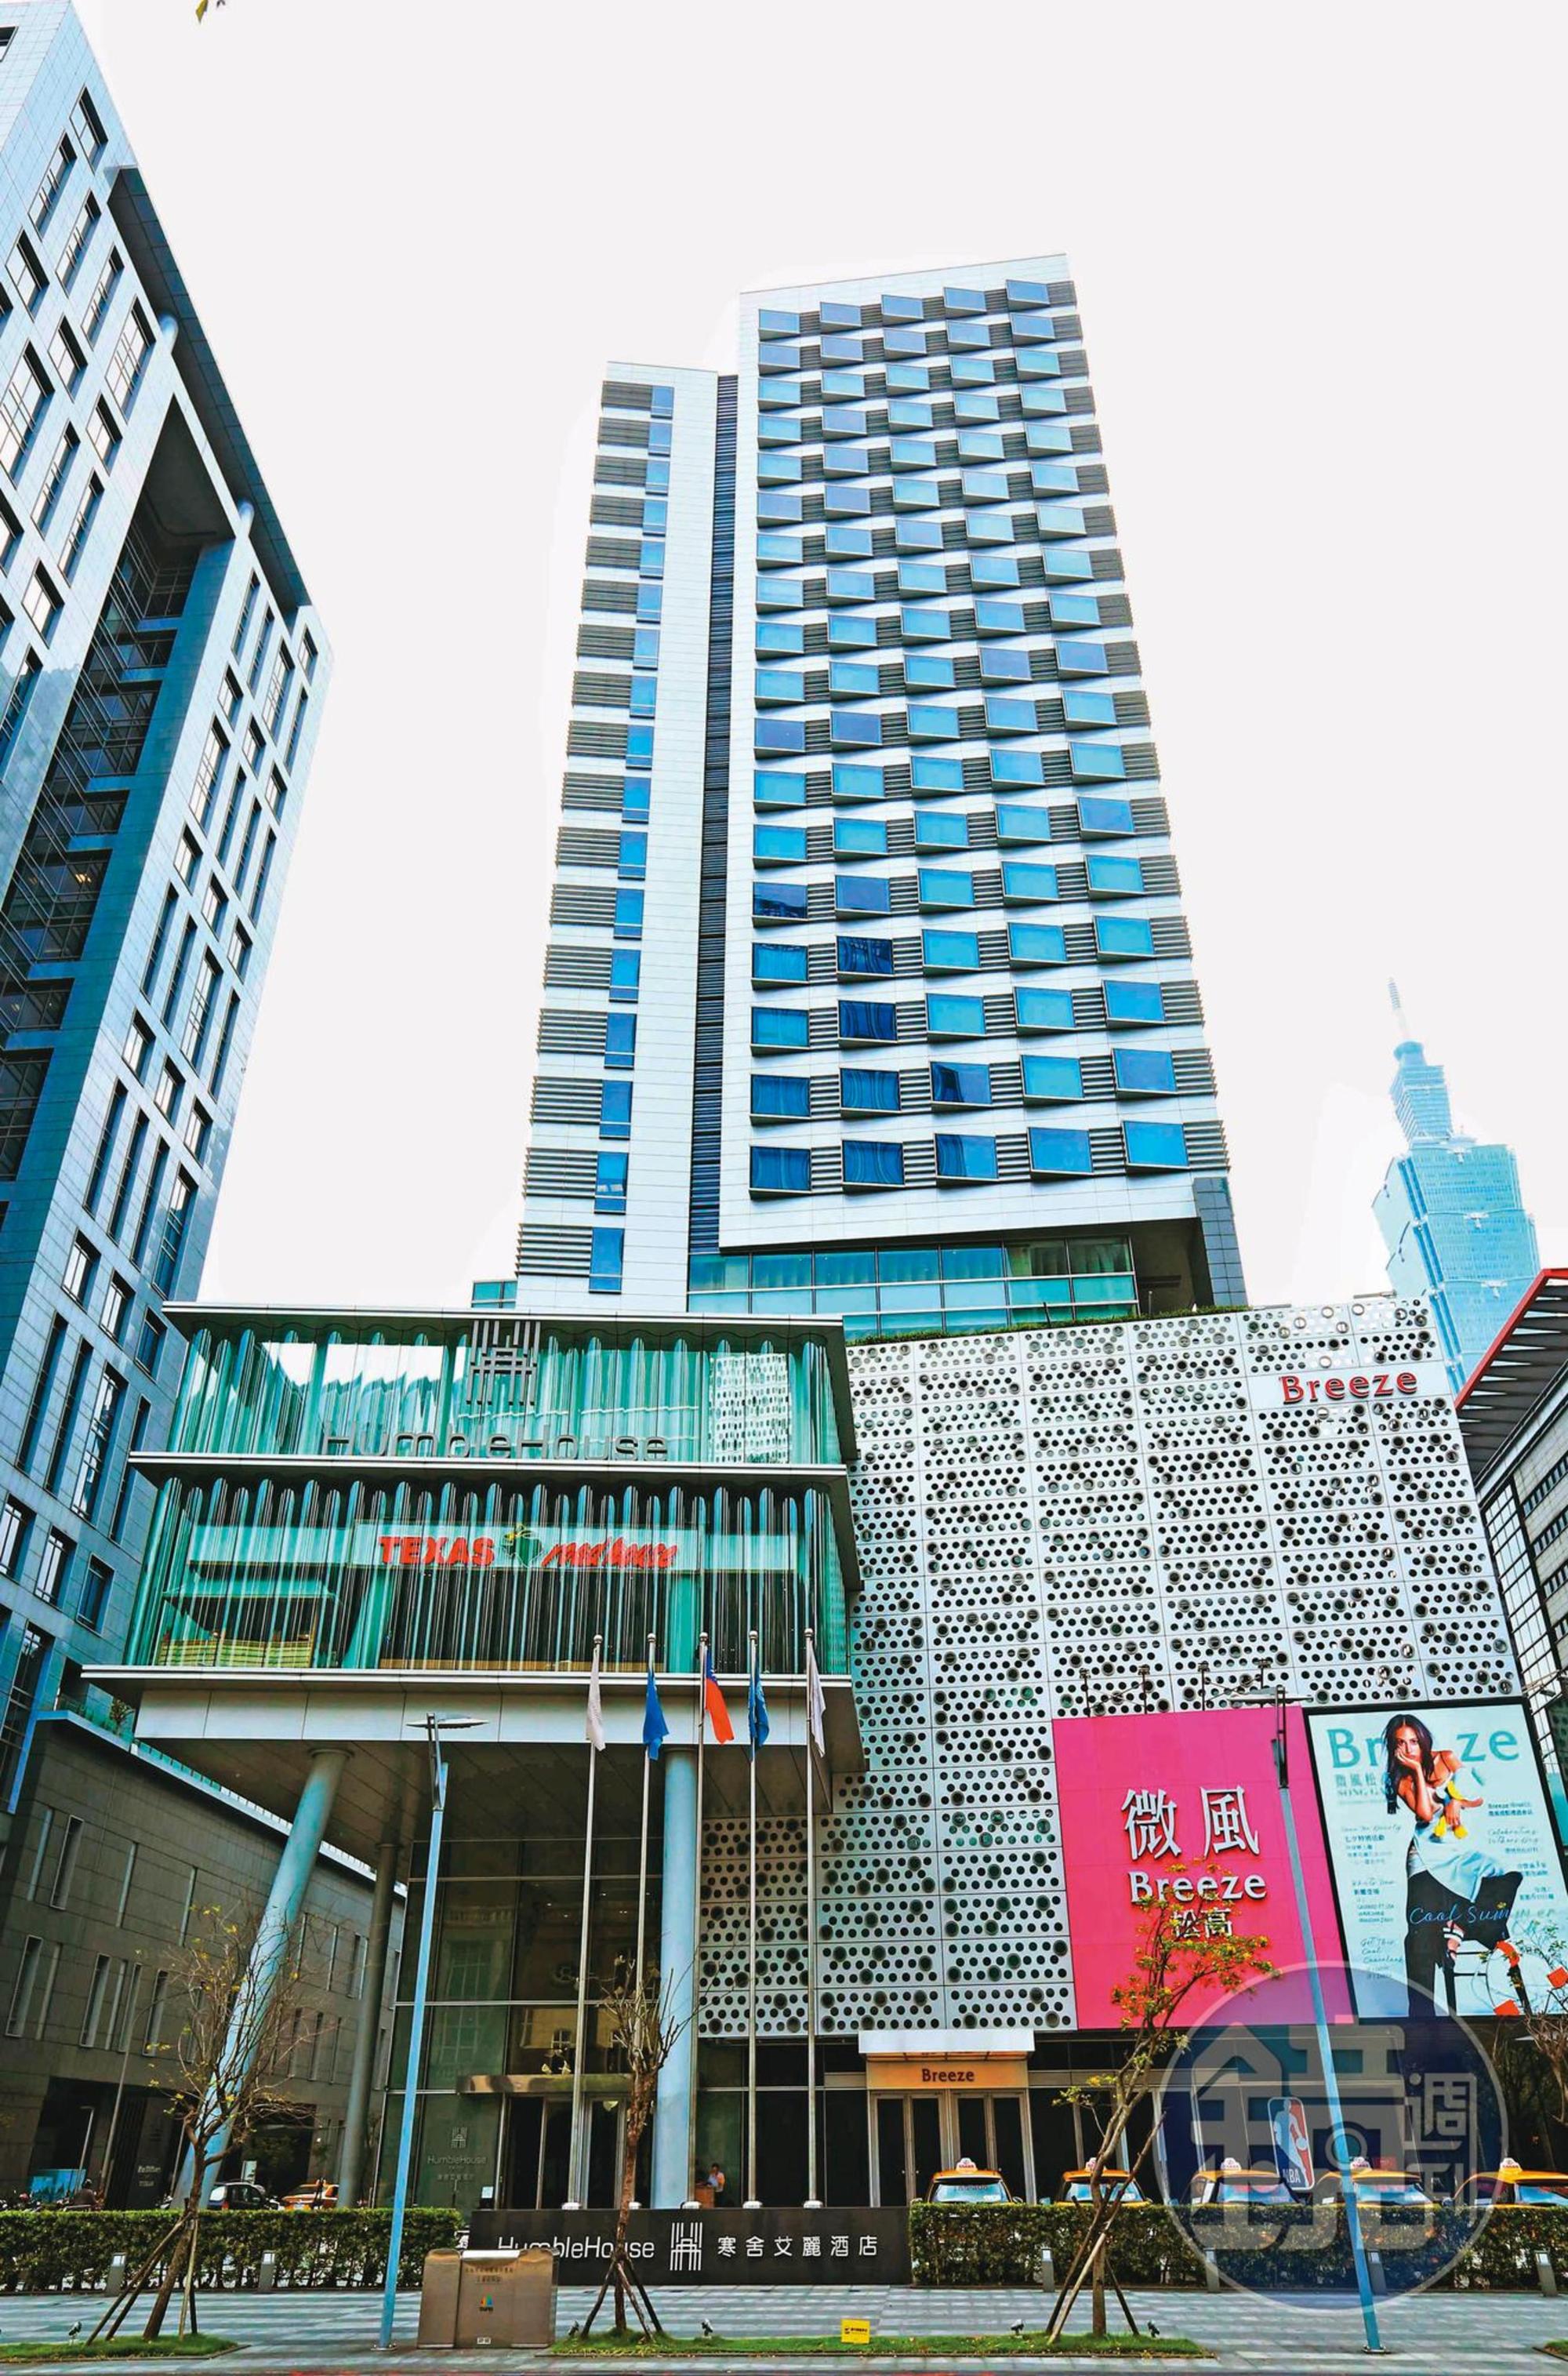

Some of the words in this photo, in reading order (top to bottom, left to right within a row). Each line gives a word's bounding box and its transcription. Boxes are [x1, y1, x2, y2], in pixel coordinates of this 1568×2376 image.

[1279, 1371, 1419, 1404] Breeze
[321, 1421, 668, 1461] HumbleHouse
[379, 1536, 495, 1565] TEXAS
[1327, 1728, 1520, 1768] Brze
[1122, 1786, 1259, 1860] 微風
[1127, 1871, 1266, 1903] Breeze
[922, 2069, 975, 2082] Breeze
[1282, 2168, 1301, 2184] NBA
[717, 2235, 879, 2258] 寒舍艾麗酒店
